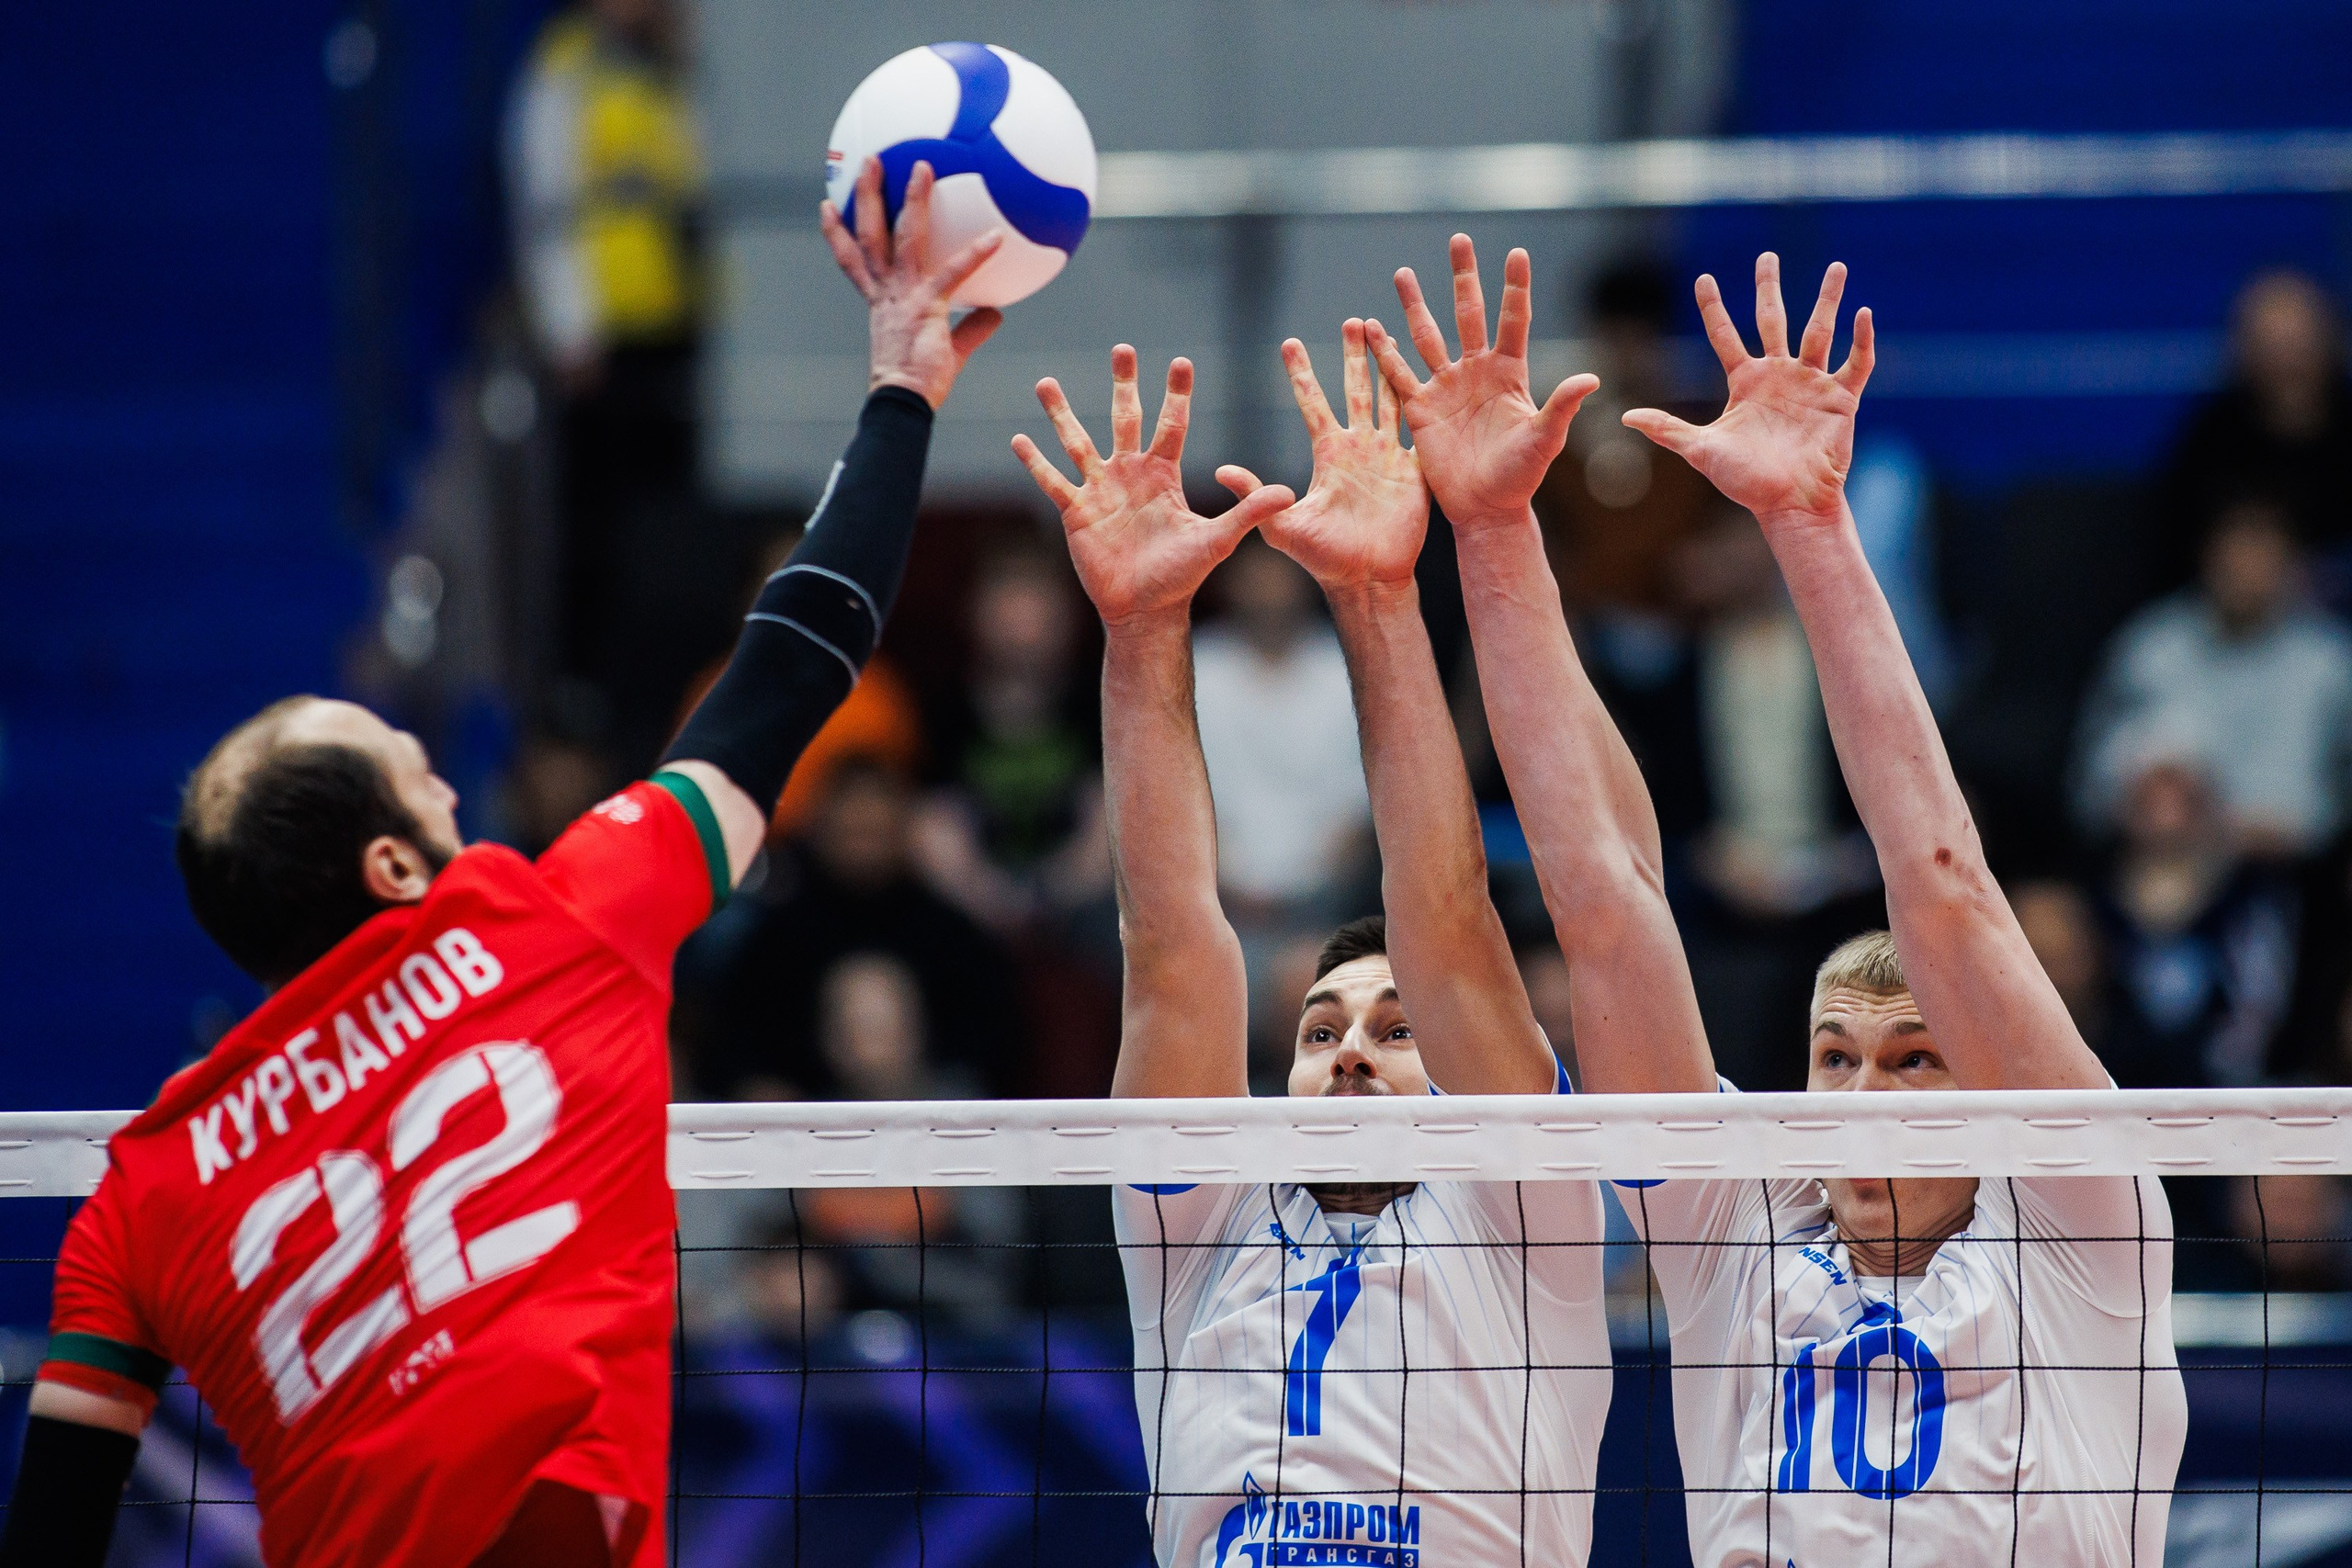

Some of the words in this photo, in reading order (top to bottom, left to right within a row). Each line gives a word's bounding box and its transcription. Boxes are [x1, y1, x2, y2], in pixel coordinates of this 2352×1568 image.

[187, 927, 504, 1185] КУРБАНОВ
[228, 1038, 581, 1427] 22
[1285, 1262, 1362, 1437] 7
[1777, 1325, 1946, 1500] 10
[1268, 1500, 1420, 1545] ГАЗПРОМ
